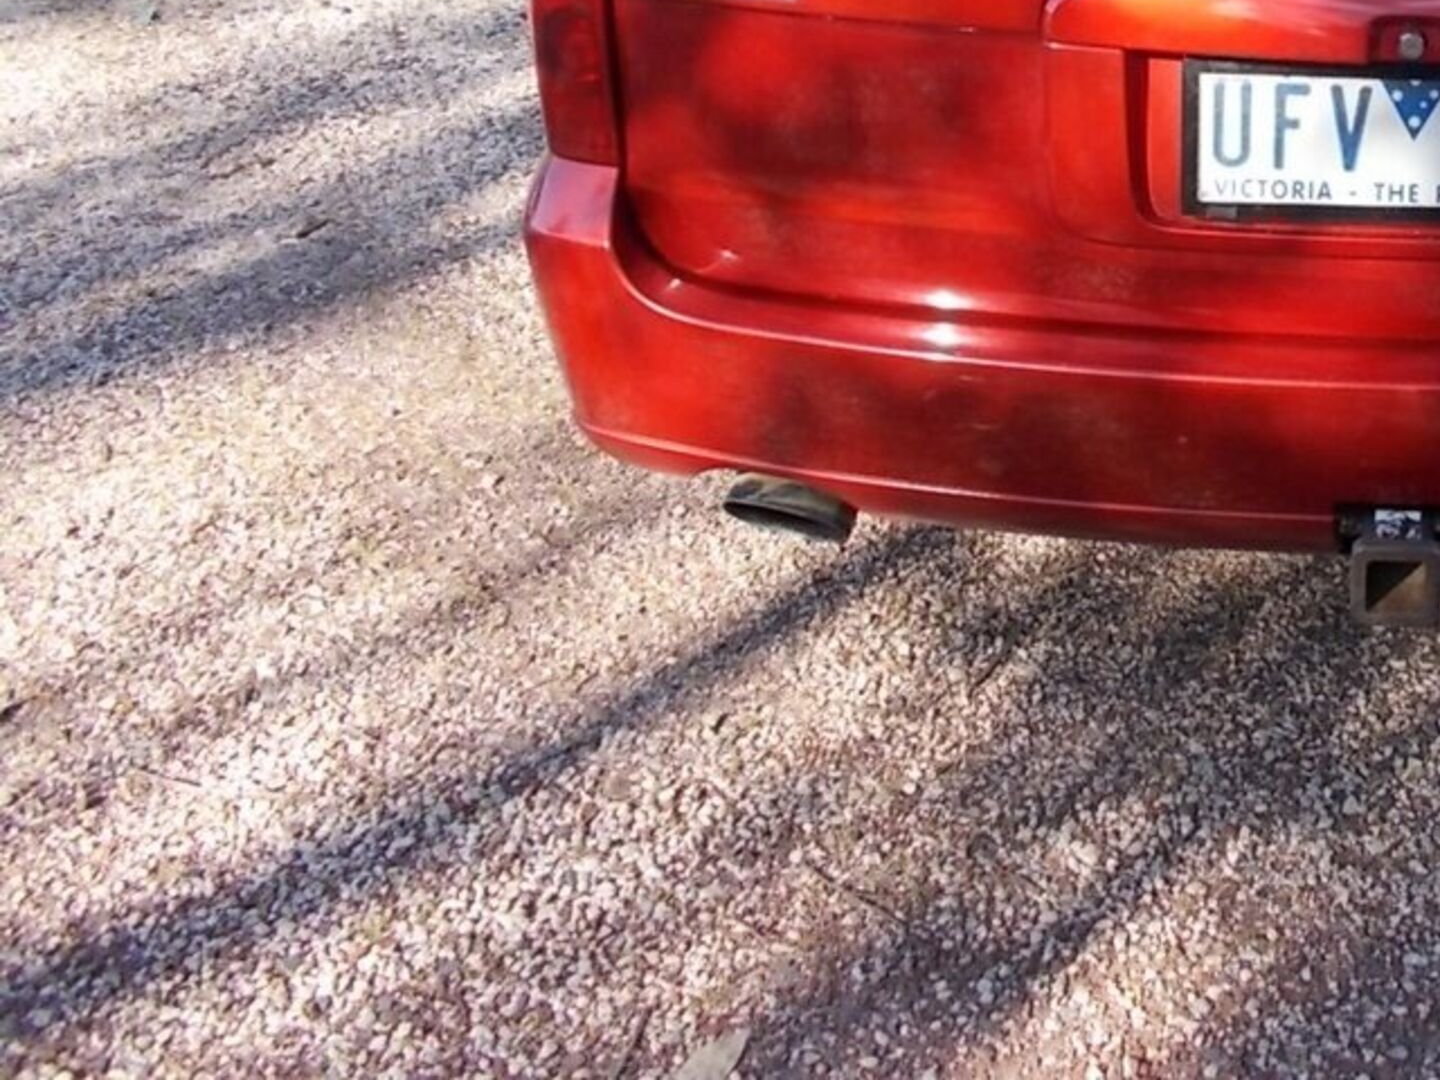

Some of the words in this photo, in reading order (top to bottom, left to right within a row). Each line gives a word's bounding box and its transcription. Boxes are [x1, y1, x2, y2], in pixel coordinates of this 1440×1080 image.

[1211, 79, 1374, 173] UFV
[1214, 178, 1333, 201] VICTORIA
[1373, 181, 1420, 204] THE
